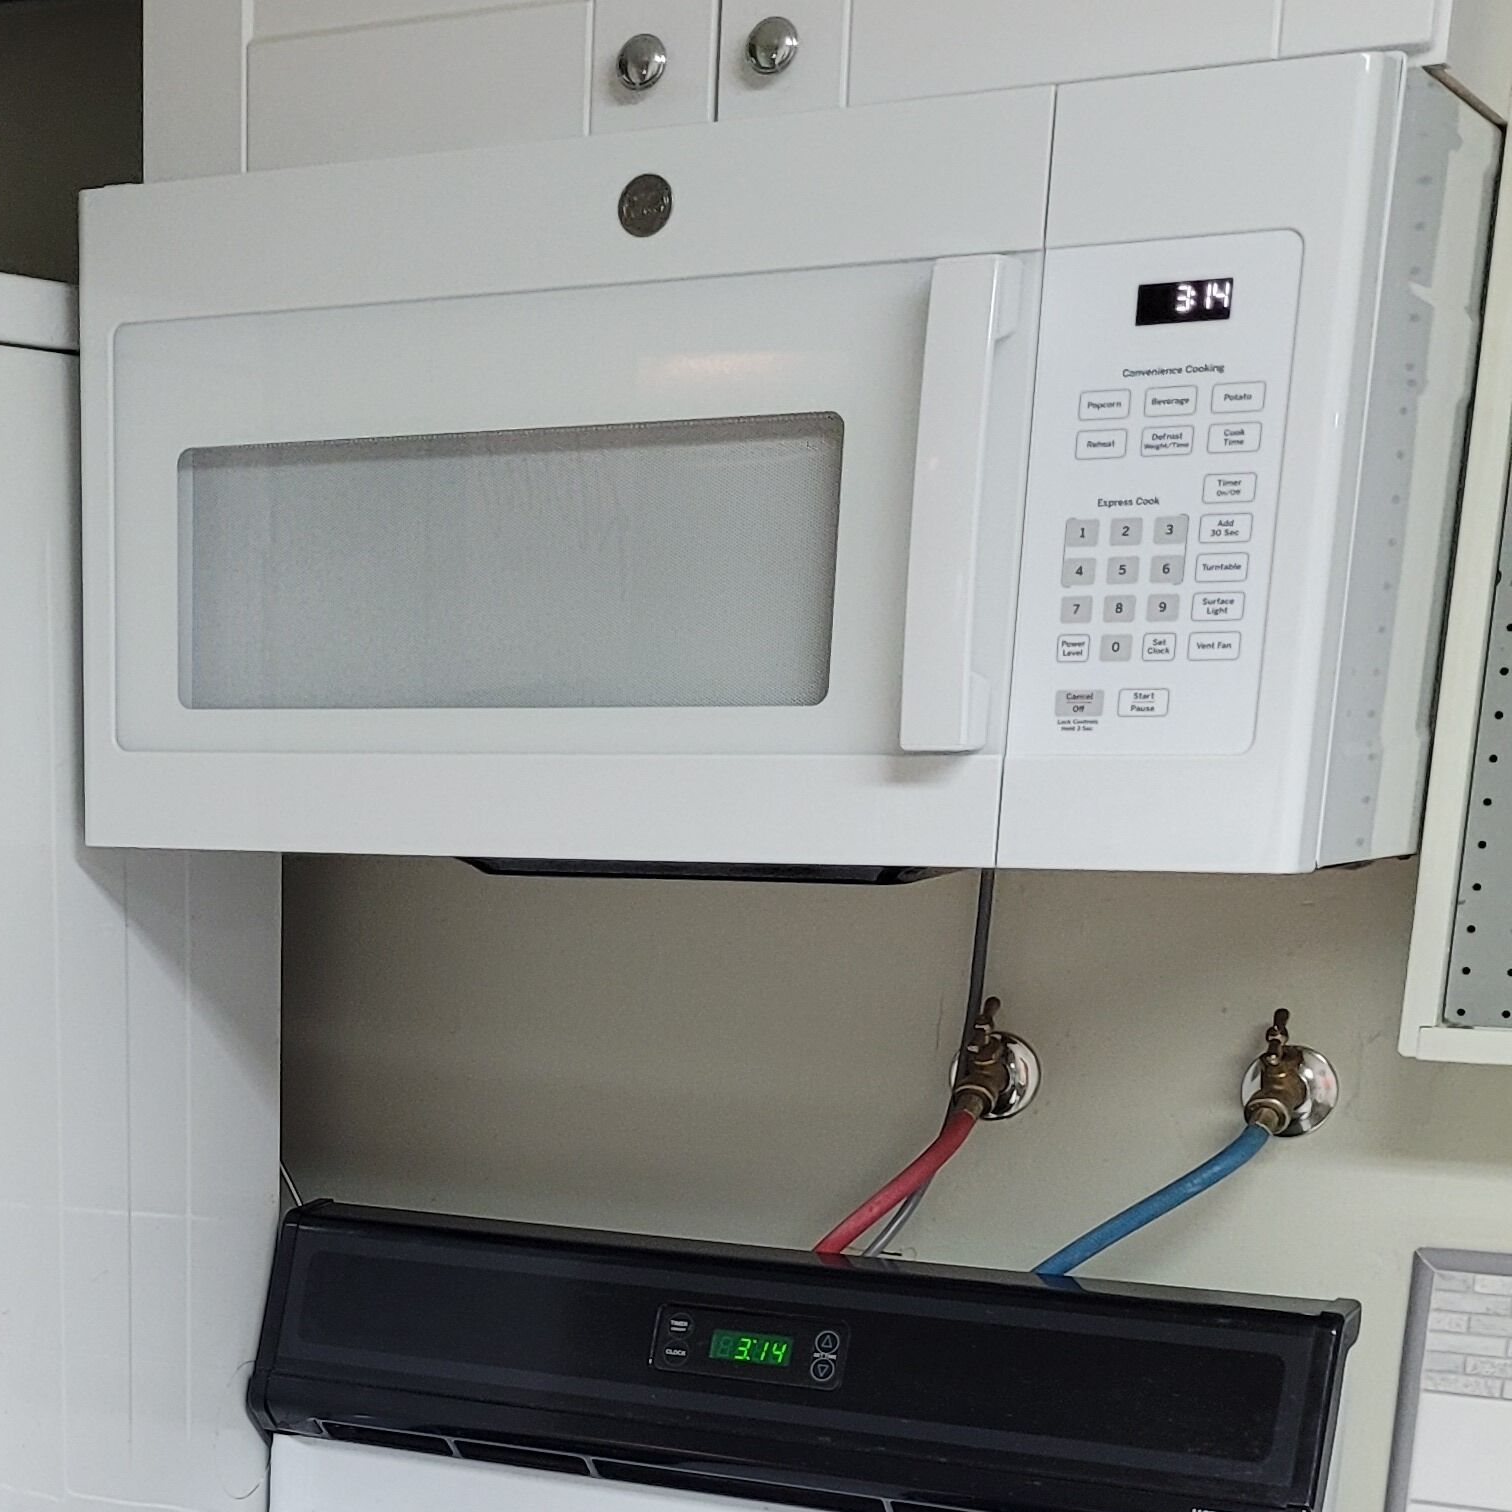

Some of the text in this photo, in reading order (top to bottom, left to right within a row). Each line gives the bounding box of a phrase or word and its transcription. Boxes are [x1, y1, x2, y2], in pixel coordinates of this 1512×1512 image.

[1176, 281, 1230, 312] 3:14
[1122, 363, 1224, 378] Convenience Cooking
[1223, 392, 1252, 401] Potato
[1087, 400, 1122, 410] Popcorn
[1151, 397, 1189, 406] Beverage
[1151, 432, 1183, 441] Defrost
[1223, 428, 1245, 437] Cook
[1086, 440, 1115, 448] Reheat
[1224, 438, 1244, 446] Time
[1217, 479, 1241, 487] Timer
[1097, 496, 1159, 508] Express Cook
[1217, 519, 1234, 527] Add
[1080, 527, 1085, 538] 1
[1121, 525, 1129, 537] 2
[1166, 524, 1173, 535] 3
[1210, 528, 1239, 537] 30 Sec
[1075, 565, 1083, 576] 4
[1118, 564, 1126, 575] 5
[1162, 563, 1170, 574] 6
[1202, 563, 1242, 571] Turntable
[1203, 597, 1235, 606] Surface
[1073, 604, 1080, 615] 7
[1115, 602, 1123, 613] 8
[1159, 602, 1166, 612] 9
[1207, 607, 1228, 616] Light
[1061, 640, 1085, 648] Power
[1152, 638, 1167, 646] Set
[1196, 641, 1232, 649] Vent Fan
[1062, 648, 1083, 656] Level
[1111, 642, 1119, 653] 0
[1147, 647, 1170, 655] Clock
[1066, 692, 1094, 700] Cancel
[1133, 692, 1155, 700] Start
[1072, 705, 1085, 713] Off
[1130, 704, 1155, 712] Pause
[665, 1348, 686, 1357] CLOCK
